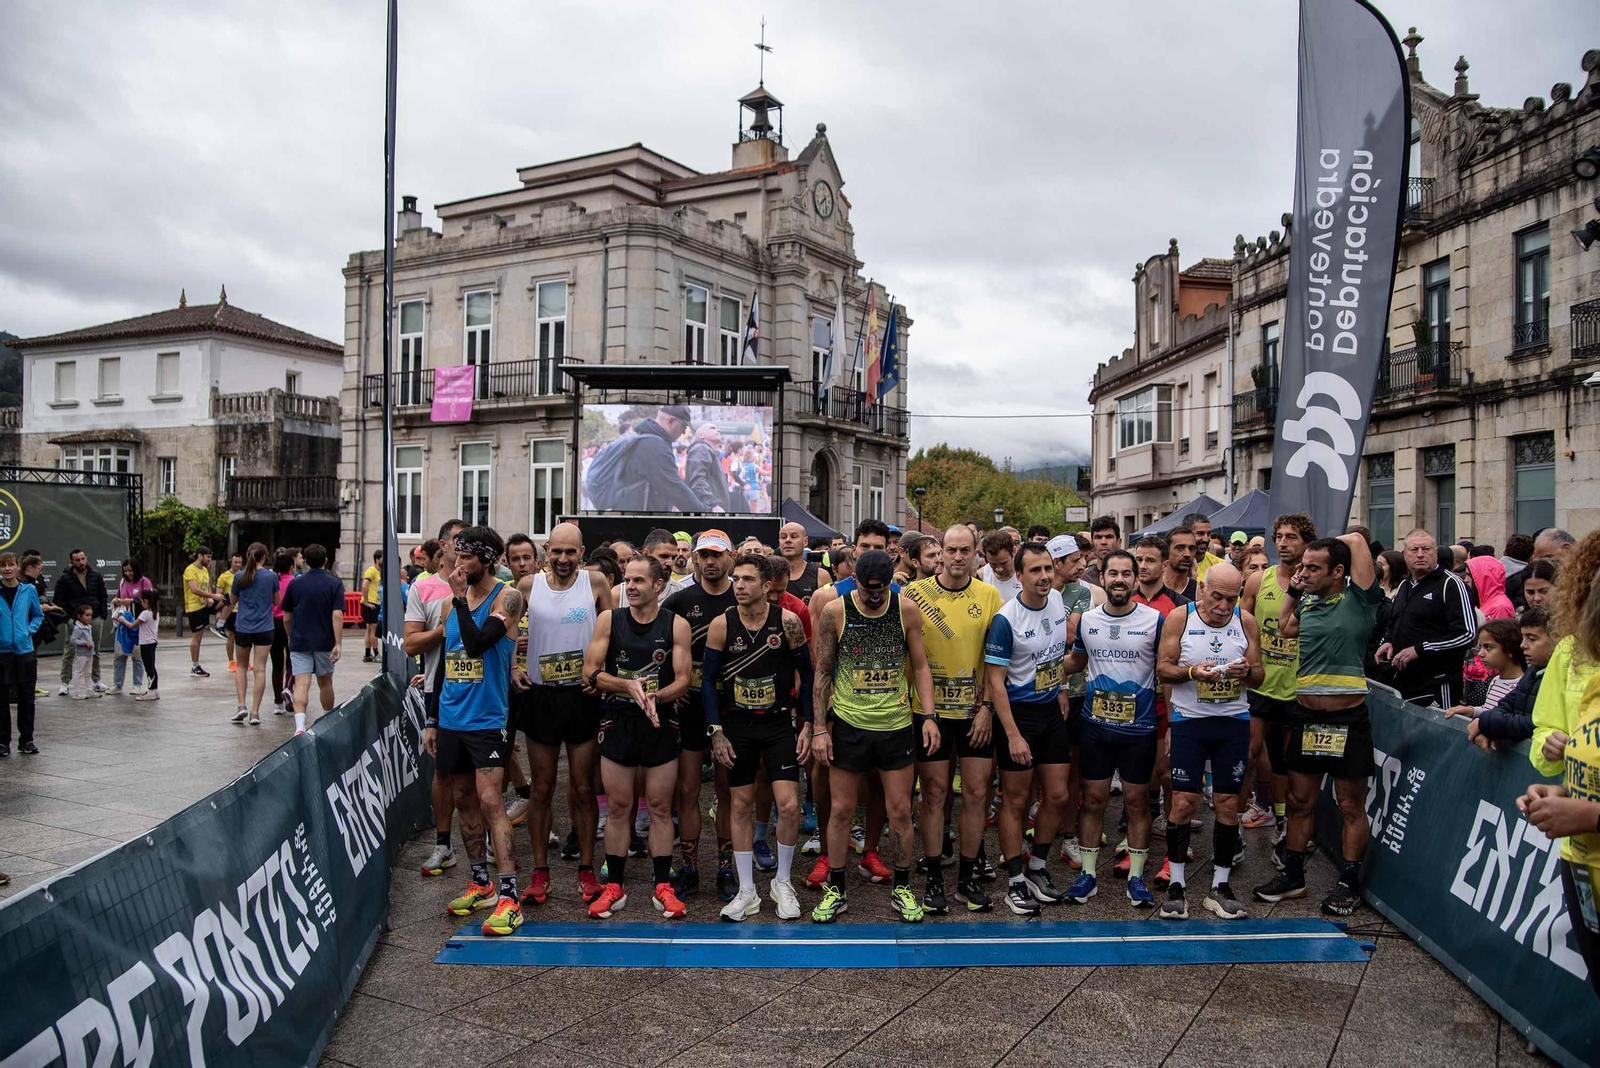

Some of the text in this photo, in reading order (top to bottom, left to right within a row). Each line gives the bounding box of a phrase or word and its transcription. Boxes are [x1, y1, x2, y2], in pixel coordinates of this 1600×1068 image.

[1271, 639, 1283, 648] 41
[1090, 649, 1140, 659] MECADOBA
[454, 661, 472, 671] 290
[555, 663, 571, 673] 44
[865, 671, 888, 682] 244
[1049, 669, 1057, 680] 15
[1210, 681, 1231, 691] 239
[742, 689, 764, 699] 468
[942, 687, 961, 698] 157
[1102, 702, 1123, 713] 333
[1314, 734, 1331, 744] 172
[1381, 795, 1409, 846] TRAIL
[301, 860, 331, 933] TRAIL
[153, 839, 322, 1068] PONTES
